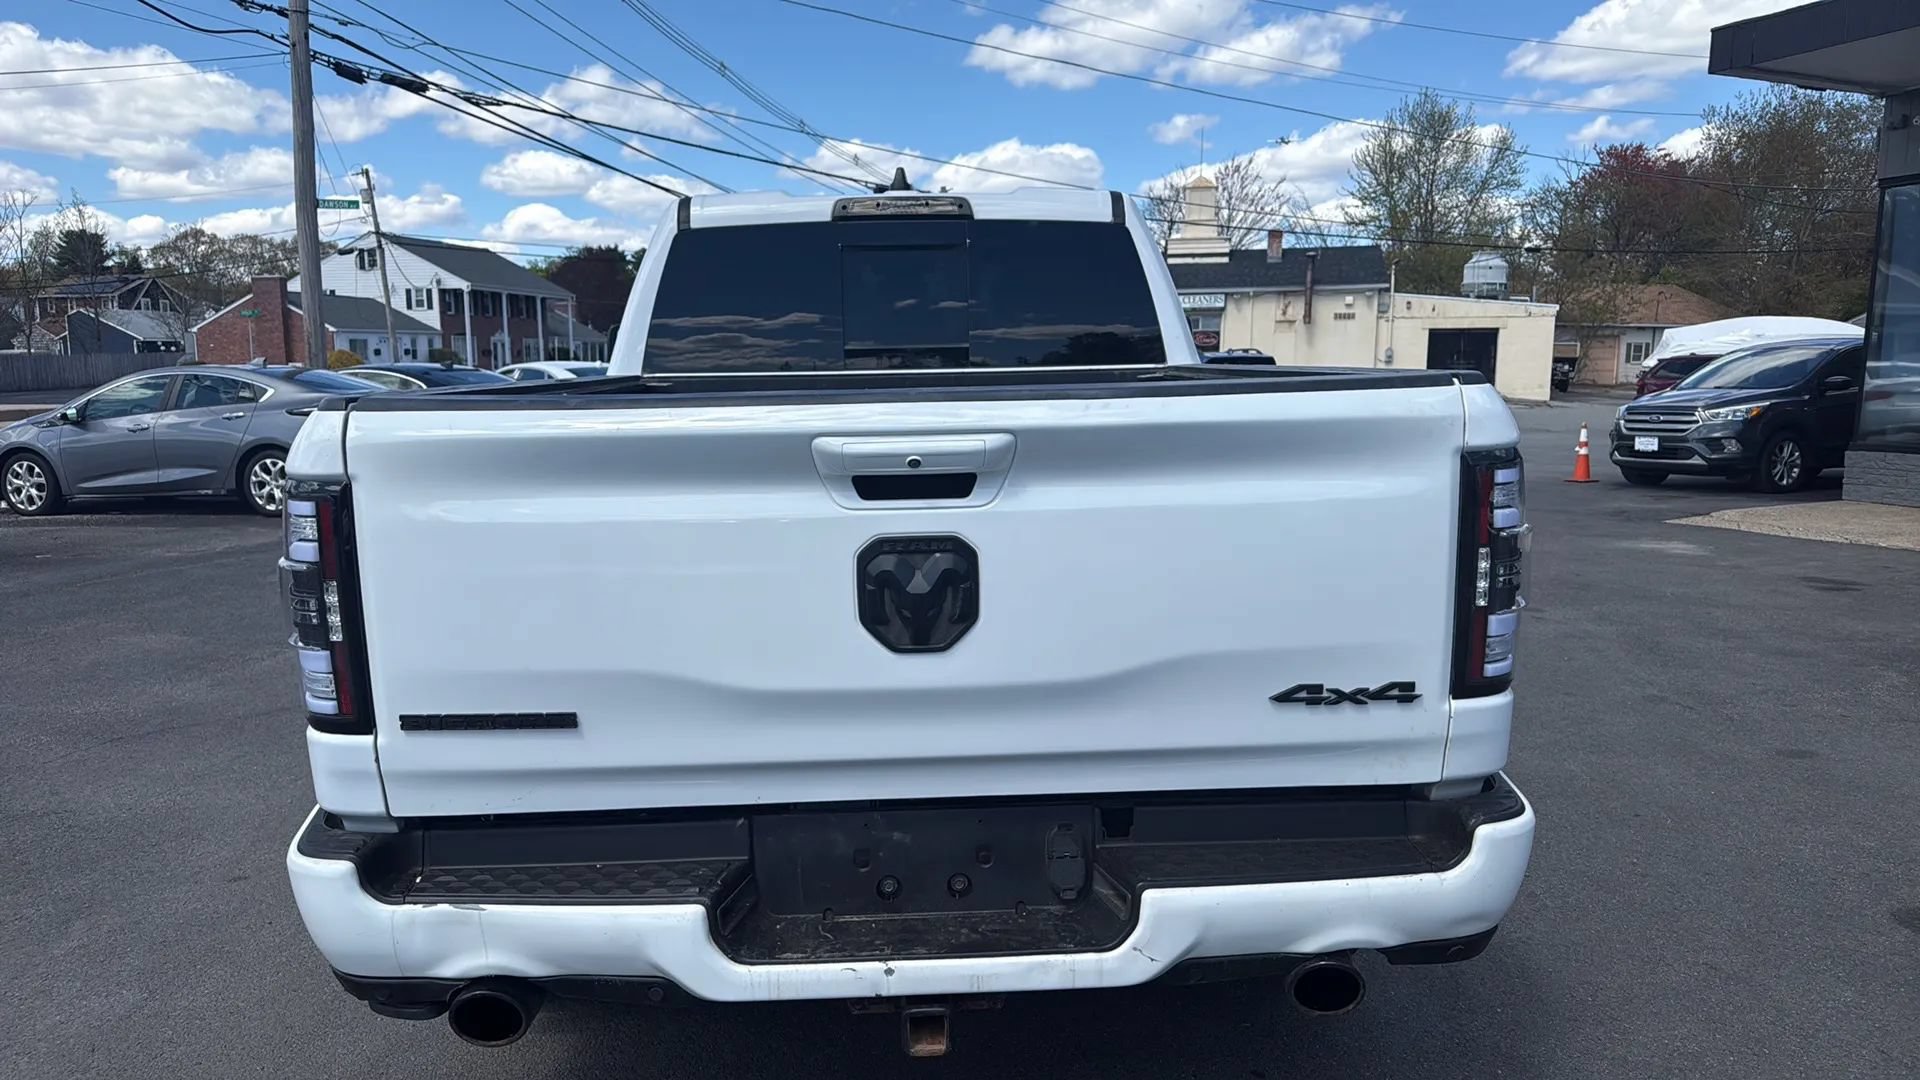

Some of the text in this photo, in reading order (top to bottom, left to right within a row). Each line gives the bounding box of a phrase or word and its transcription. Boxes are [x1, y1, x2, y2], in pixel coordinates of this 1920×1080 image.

[319, 200, 348, 209] DAWSON
[1182, 295, 1224, 304] CLEANERS
[1268, 681, 1423, 706] 4x4
